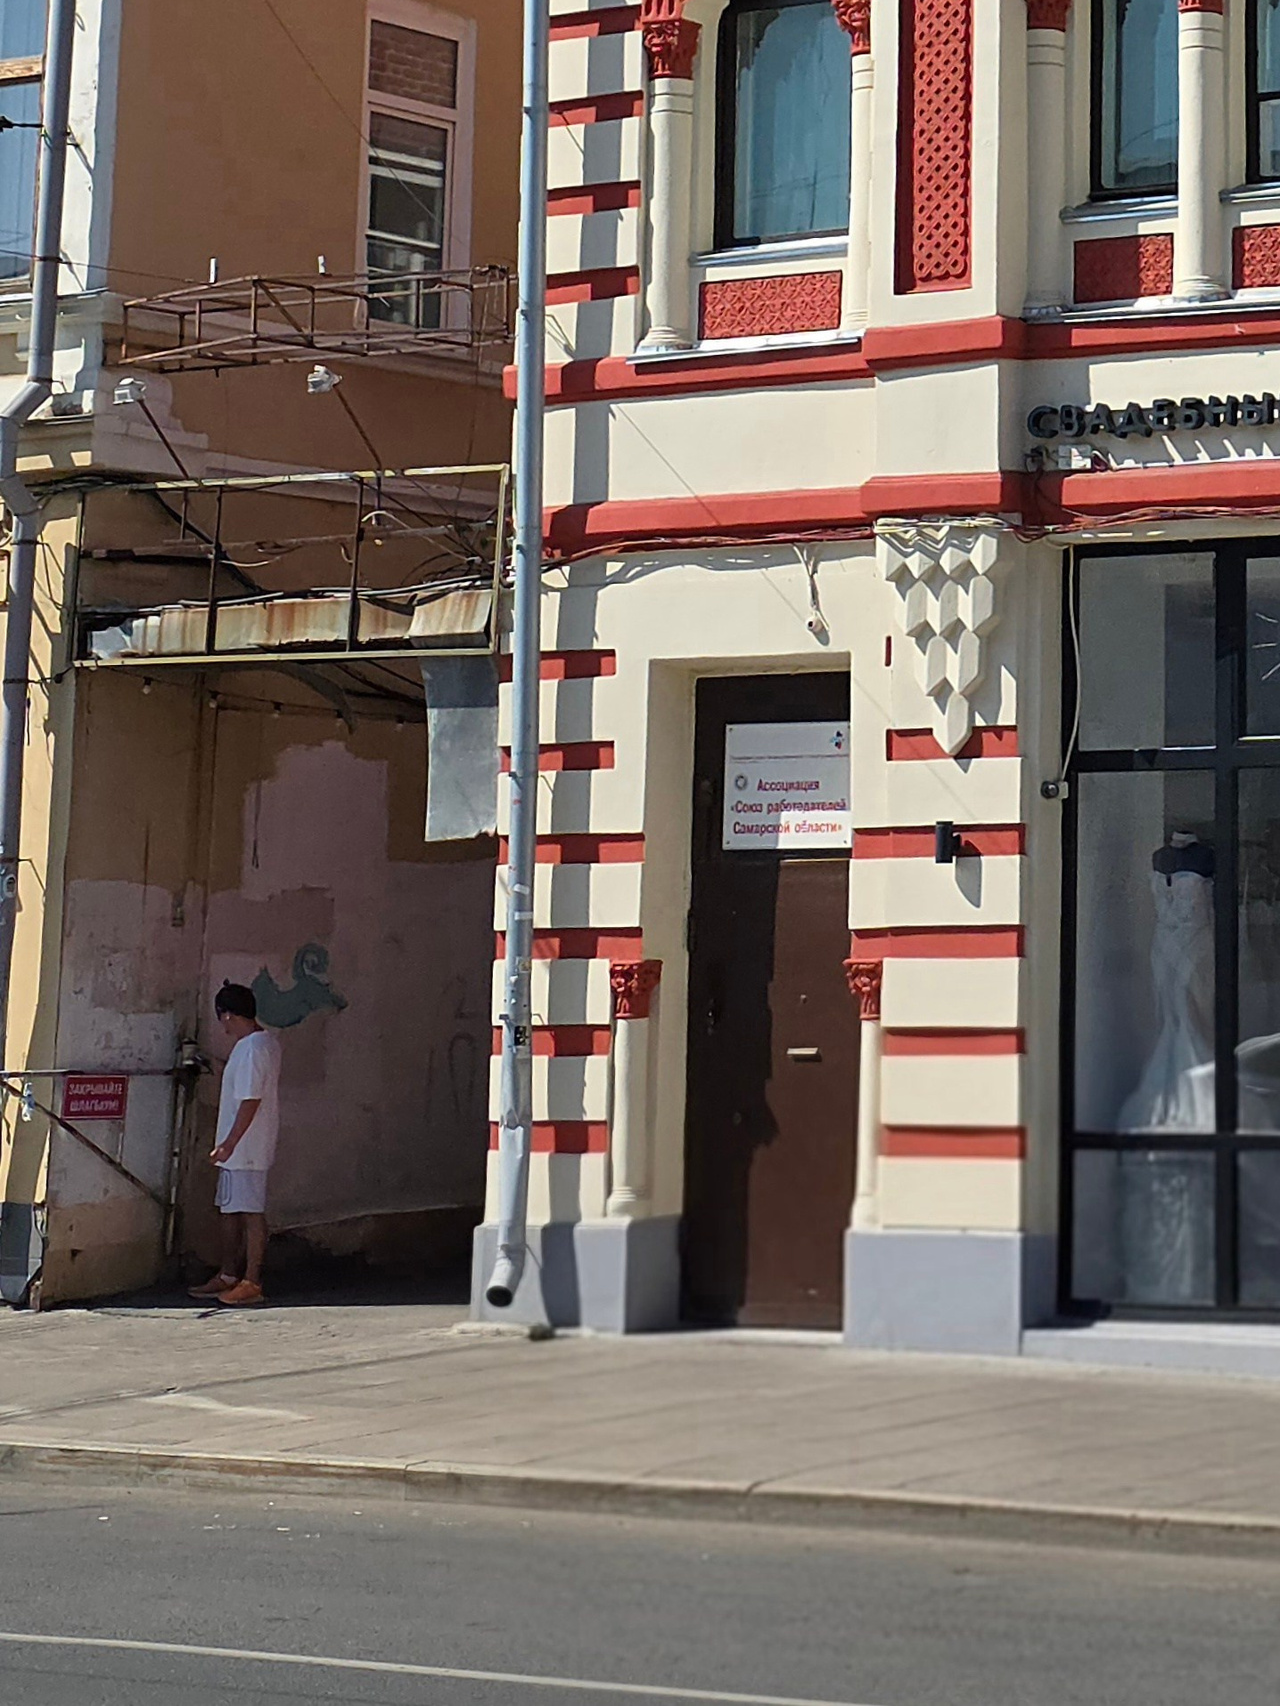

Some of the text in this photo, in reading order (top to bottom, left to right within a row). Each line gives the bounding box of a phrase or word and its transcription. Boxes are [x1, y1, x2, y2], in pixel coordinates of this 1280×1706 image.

[757, 778, 820, 793] Ассоциация
[767, 798, 847, 815] работодателей
[733, 821, 791, 837] Самарской
